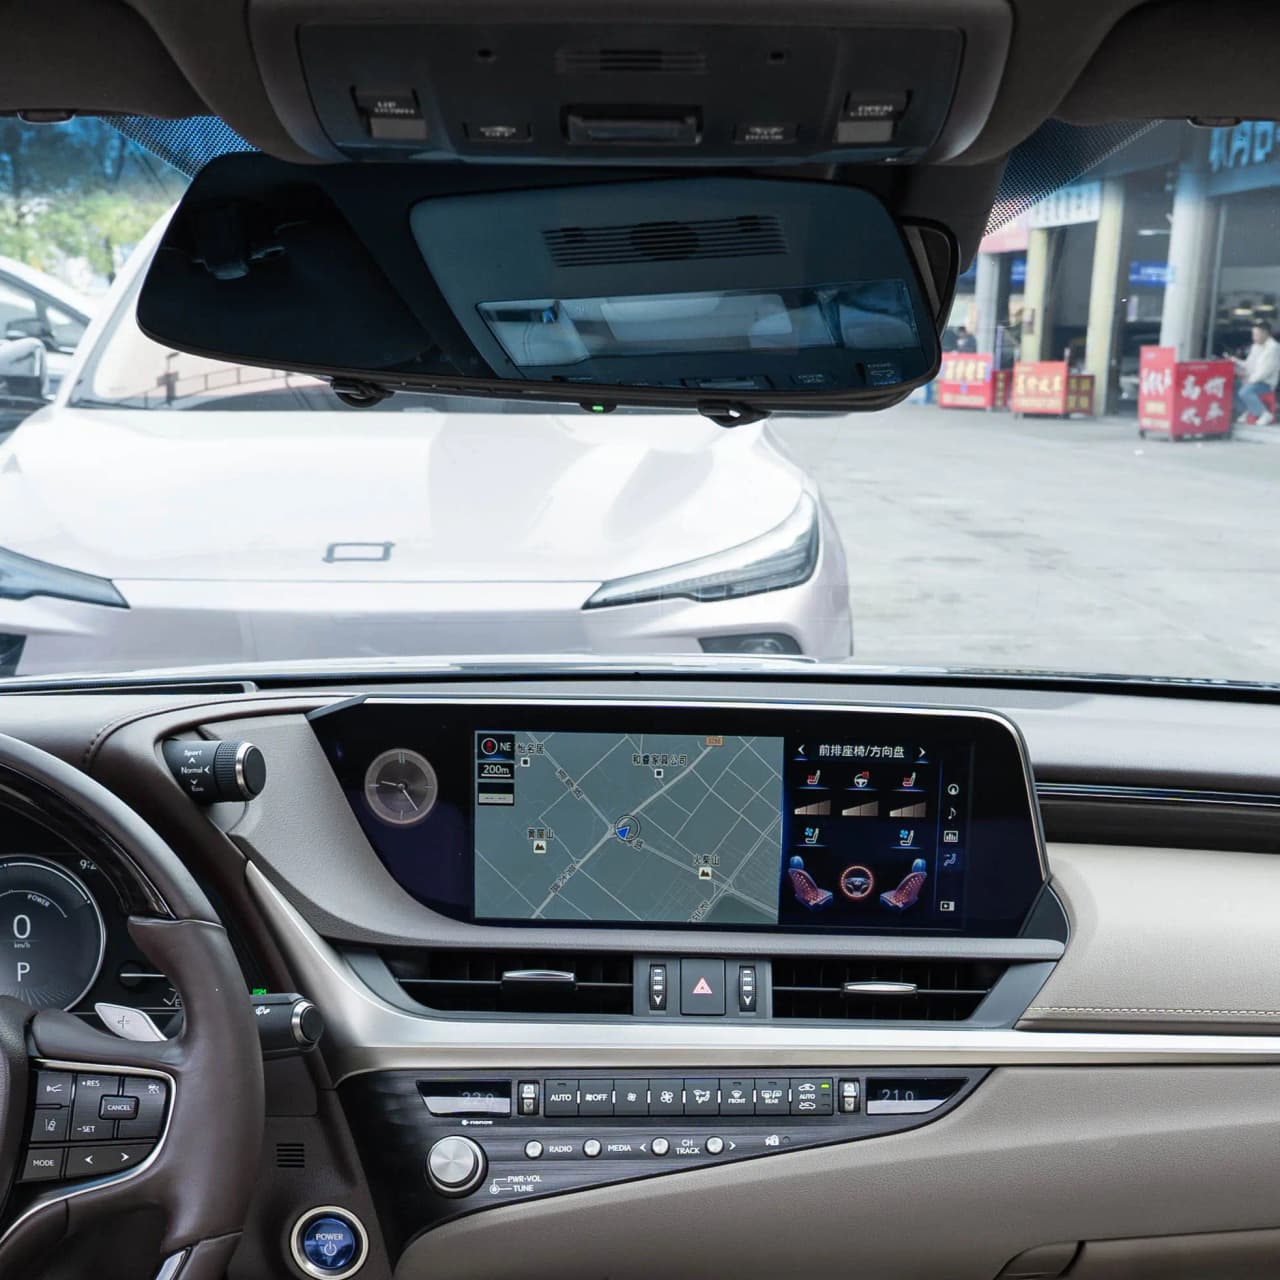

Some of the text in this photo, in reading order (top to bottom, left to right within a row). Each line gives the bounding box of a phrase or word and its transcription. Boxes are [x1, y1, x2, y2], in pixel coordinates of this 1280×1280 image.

[499, 742, 512, 751] NE
[184, 749, 203, 757] Sport
[818, 744, 905, 758] 前排座椅/方向盘
[181, 766, 203, 774] Normal
[483, 764, 510, 774] 200m
[27, 893, 51, 908] POWER
[13, 914, 31, 939] 0
[14, 941, 31, 949] km/h
[17, 962, 30, 982] P
[681, 1139, 693, 1147] CH
[549, 1145, 573, 1153] RADIO
[608, 1144, 632, 1152] MEDIA
[676, 1147, 700, 1155] TRACK
[33, 1159, 55, 1167] MODE
[315, 1233, 344, 1241] POWER
